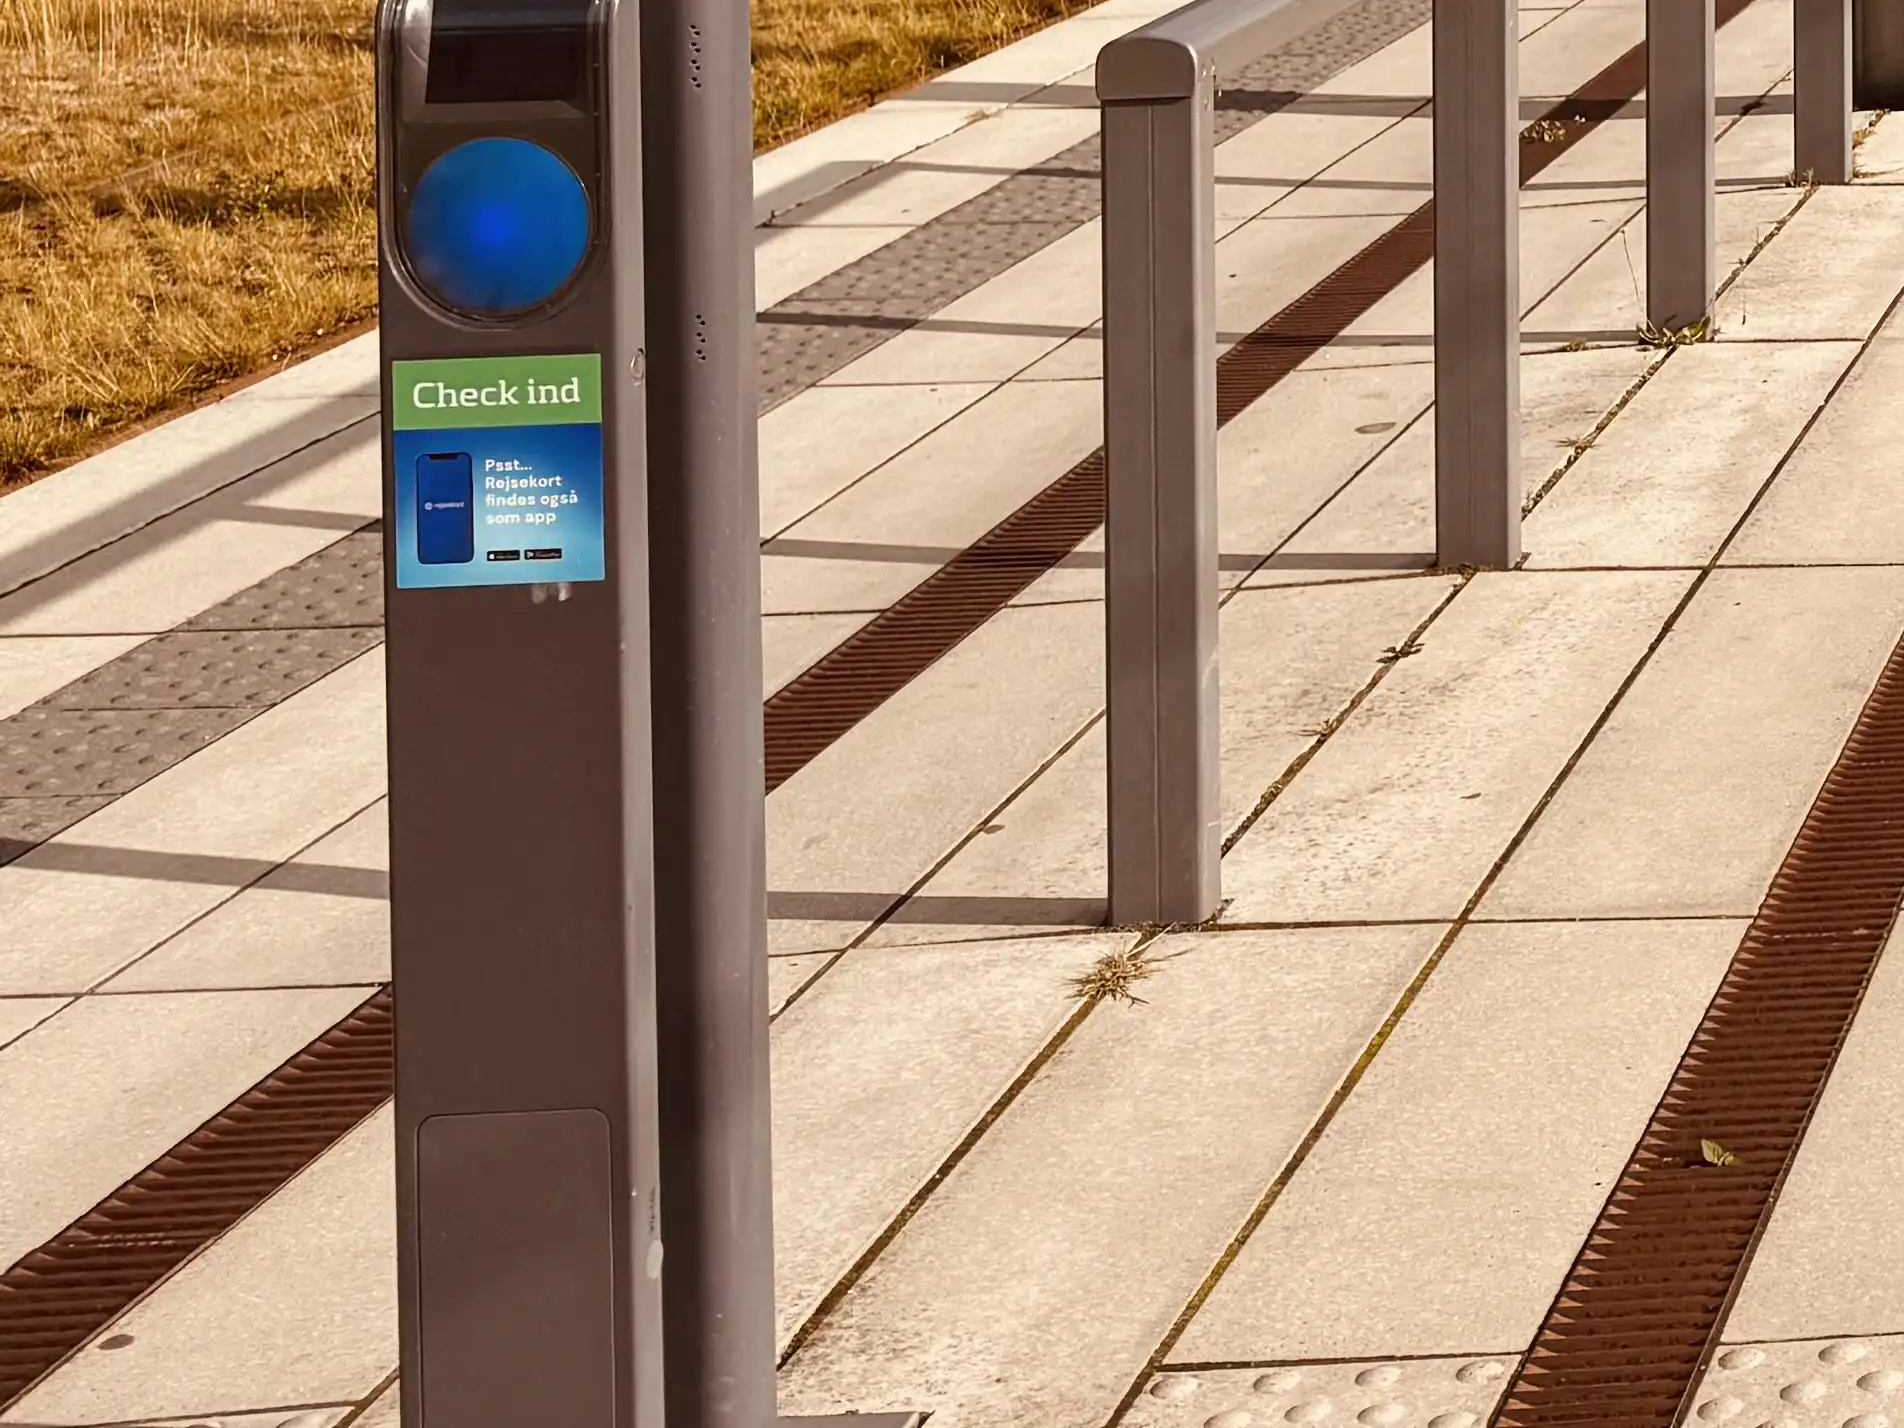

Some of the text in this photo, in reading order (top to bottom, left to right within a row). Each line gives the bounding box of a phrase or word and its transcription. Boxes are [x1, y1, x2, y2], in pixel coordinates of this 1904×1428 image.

[412, 376, 581, 409] Check ind
[485, 475, 562, 492] Rejsekort
[485, 490, 579, 508] findes også
[485, 513, 557, 525] som app
